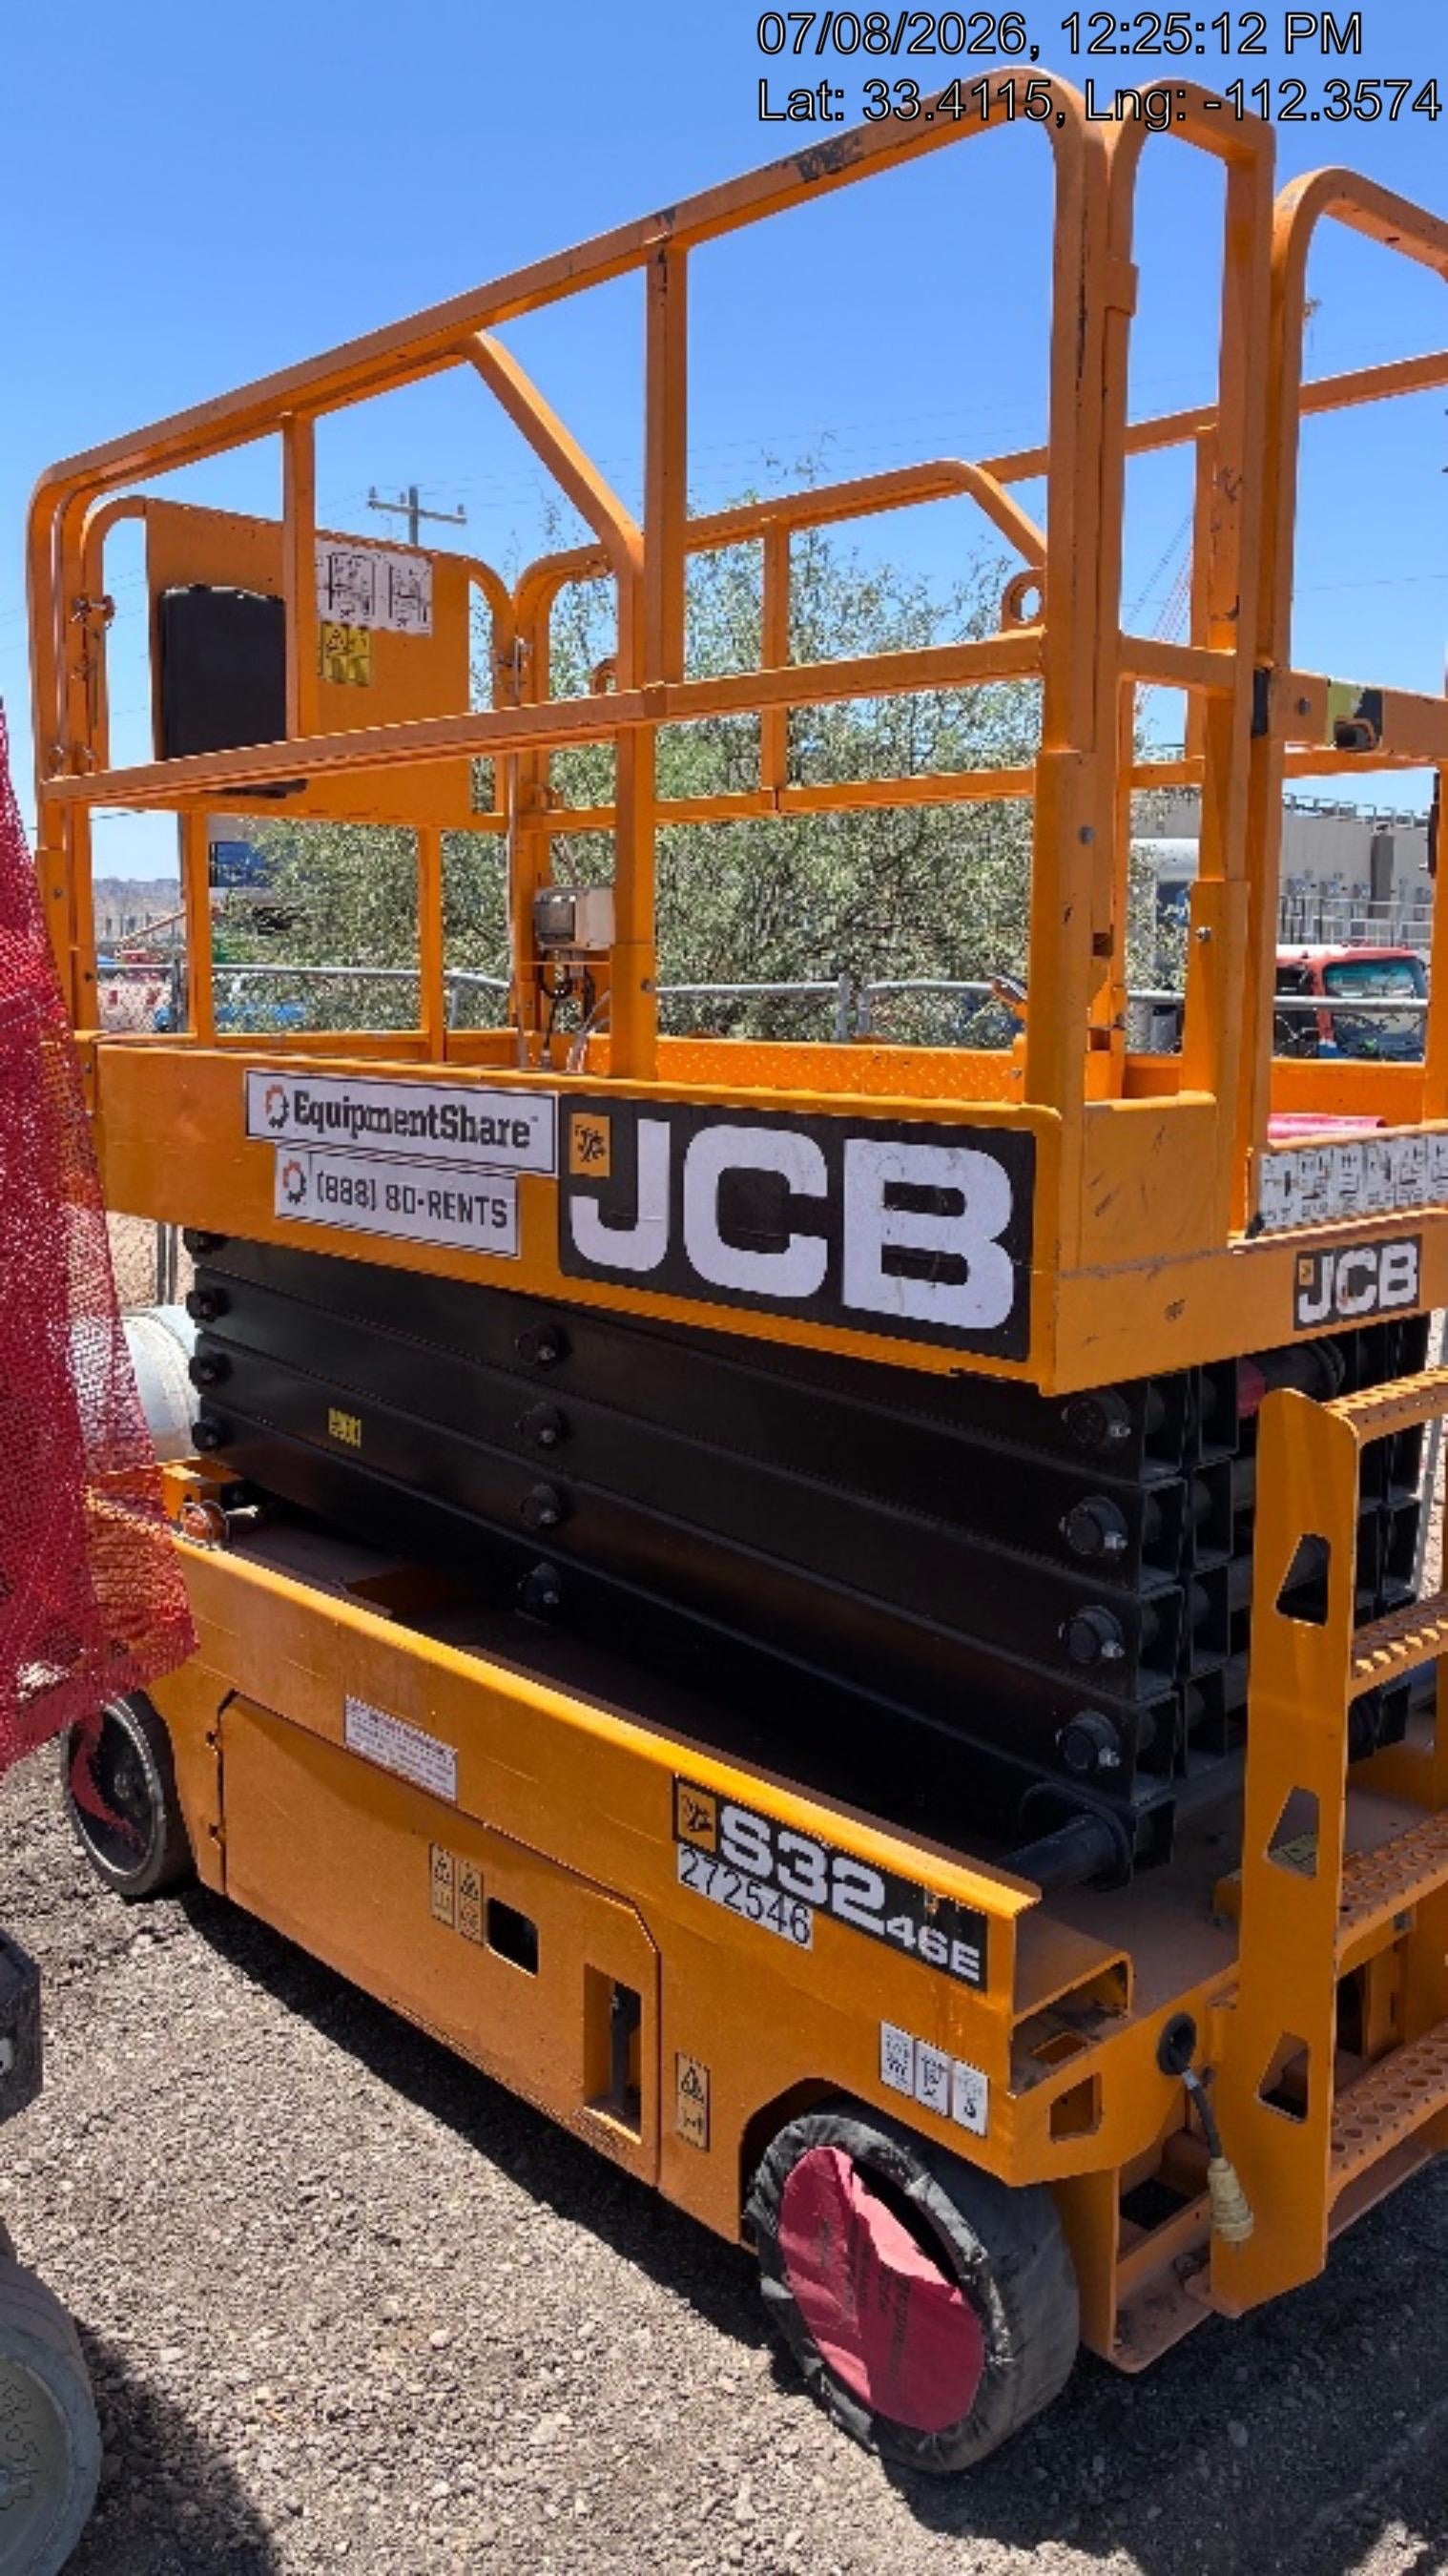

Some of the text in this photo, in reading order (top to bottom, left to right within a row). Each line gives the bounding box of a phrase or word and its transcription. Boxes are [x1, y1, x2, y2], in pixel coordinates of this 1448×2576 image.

[316, 1169, 508, 1229] (888) 80-RENTS
[569, 1118, 1014, 1329] JCB
[1297, 1242, 1417, 1323] JCB
[679, 1846, 810, 1943] 272546
